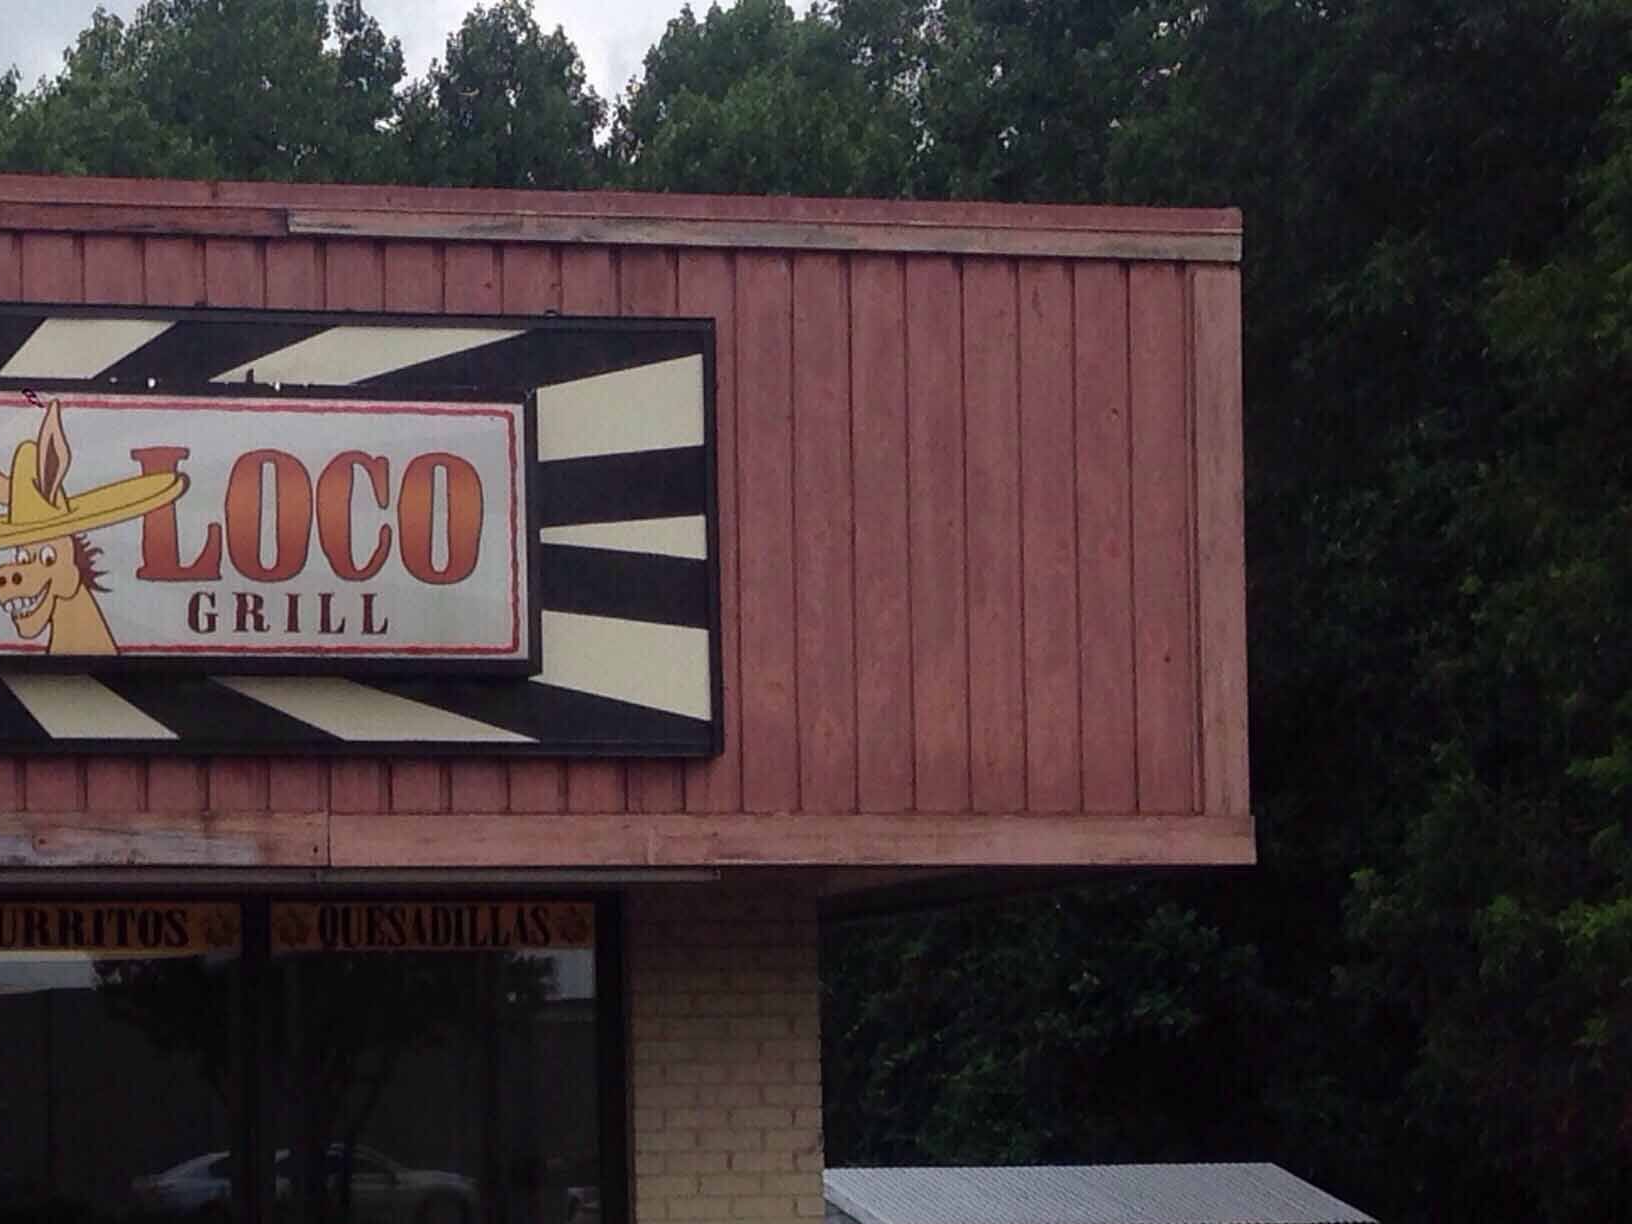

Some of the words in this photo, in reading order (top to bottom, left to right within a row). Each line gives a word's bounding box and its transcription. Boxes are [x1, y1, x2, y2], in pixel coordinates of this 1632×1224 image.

[130, 447, 485, 585] LOCO
[187, 592, 389, 636] GRILL
[318, 904, 552, 949] QUESADILLAS
